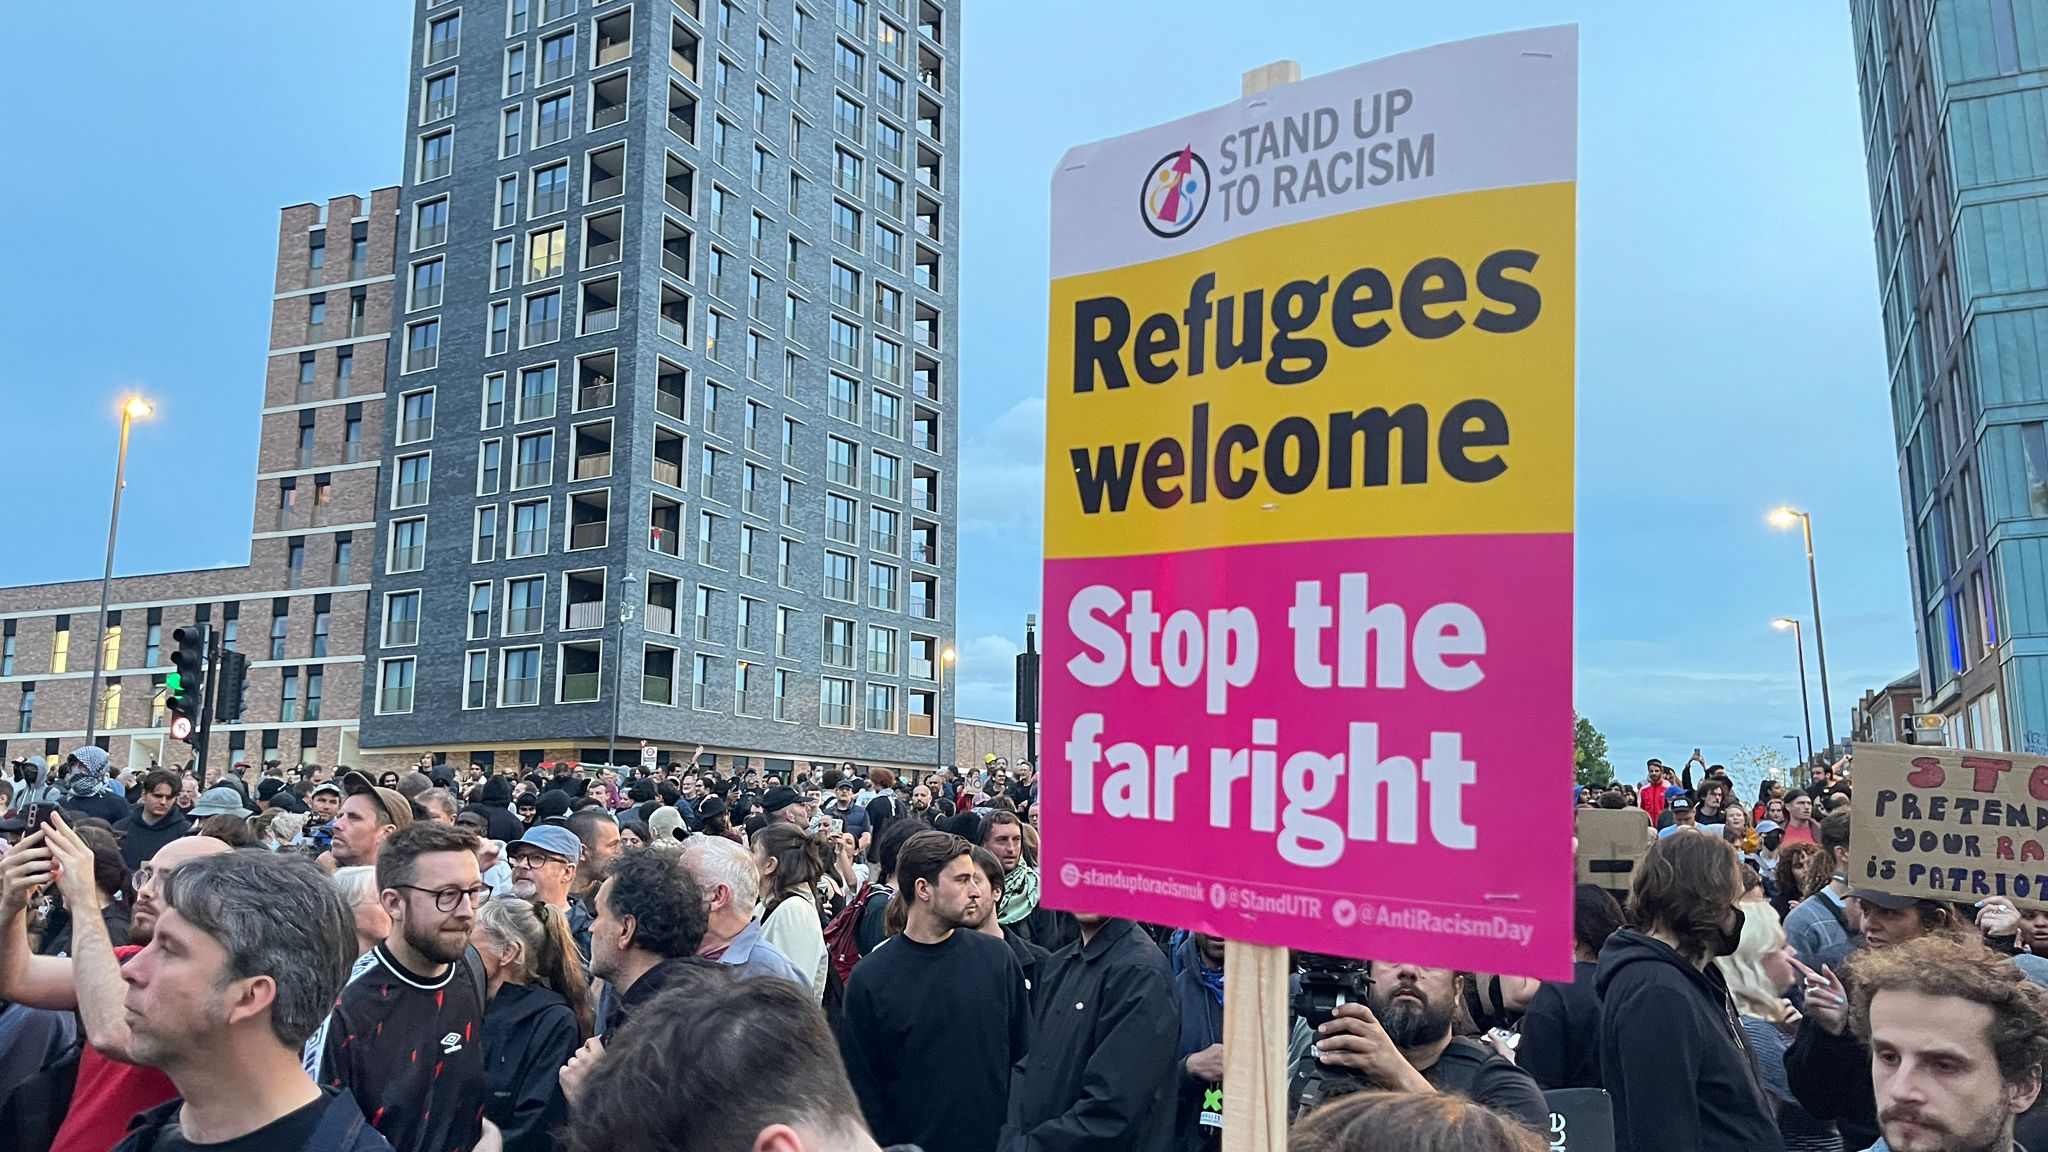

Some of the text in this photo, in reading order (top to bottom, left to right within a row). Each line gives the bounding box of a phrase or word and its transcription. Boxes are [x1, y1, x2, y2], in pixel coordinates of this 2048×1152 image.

[1218, 132, 1435, 222] TO RACISM
[1219, 88, 1413, 176] STAND UP
[1073, 248, 1542, 394] Refugees
[1070, 398, 1510, 515] welcome
[1066, 572, 1488, 714] Stop the
[966, 779, 982, 789] NO
[1065, 712, 1478, 868] far right
[1892, 826, 2044, 862] YOUR RA
[1082, 867, 1534, 946] standuptoracismuk @StandUTR @AntiRacismDay
